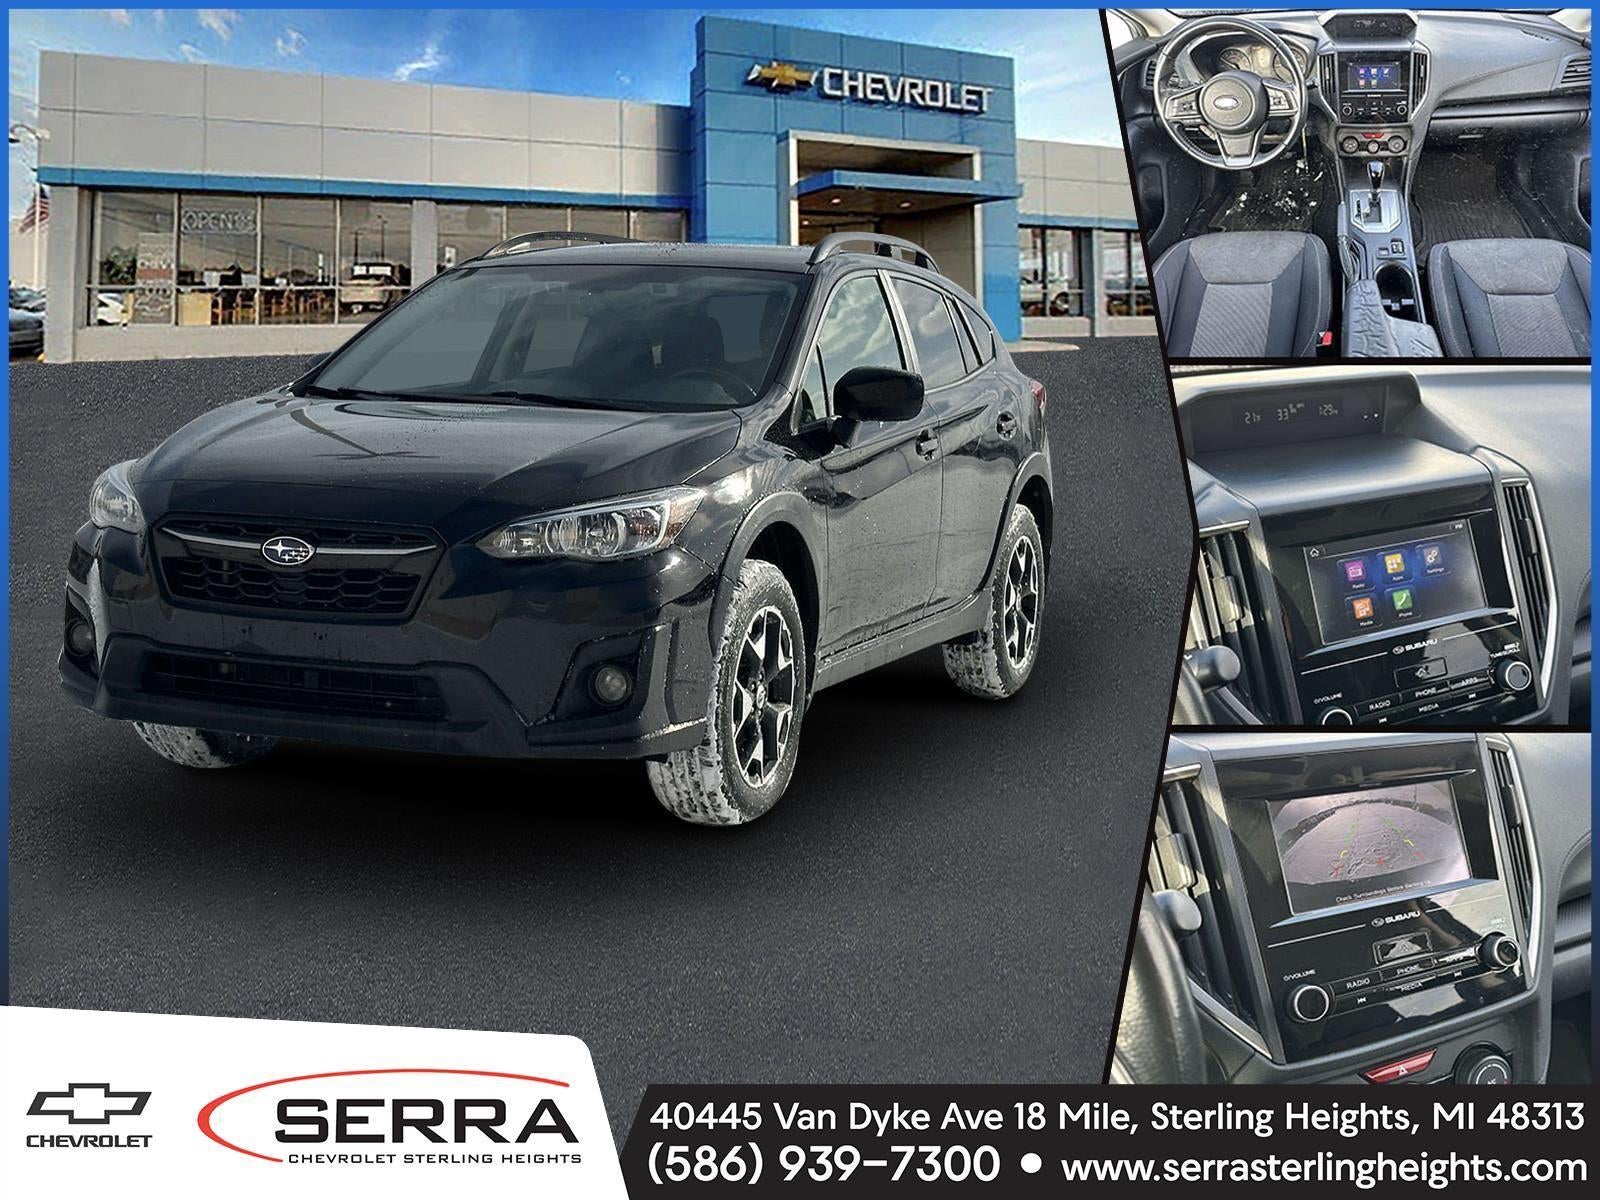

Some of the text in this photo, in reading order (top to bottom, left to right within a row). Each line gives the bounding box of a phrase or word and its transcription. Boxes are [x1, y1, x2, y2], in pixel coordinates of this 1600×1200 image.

[823, 67, 993, 113] CHEVROLET
[1404, 638, 1438, 652] SUBARU
[1415, 686, 1437, 698] PHONE
[1369, 700, 1391, 711] RADIO
[1418, 702, 1440, 713] MEDIA
[1384, 910, 1421, 924] SUBARU
[1346, 977, 1371, 989] RADIO
